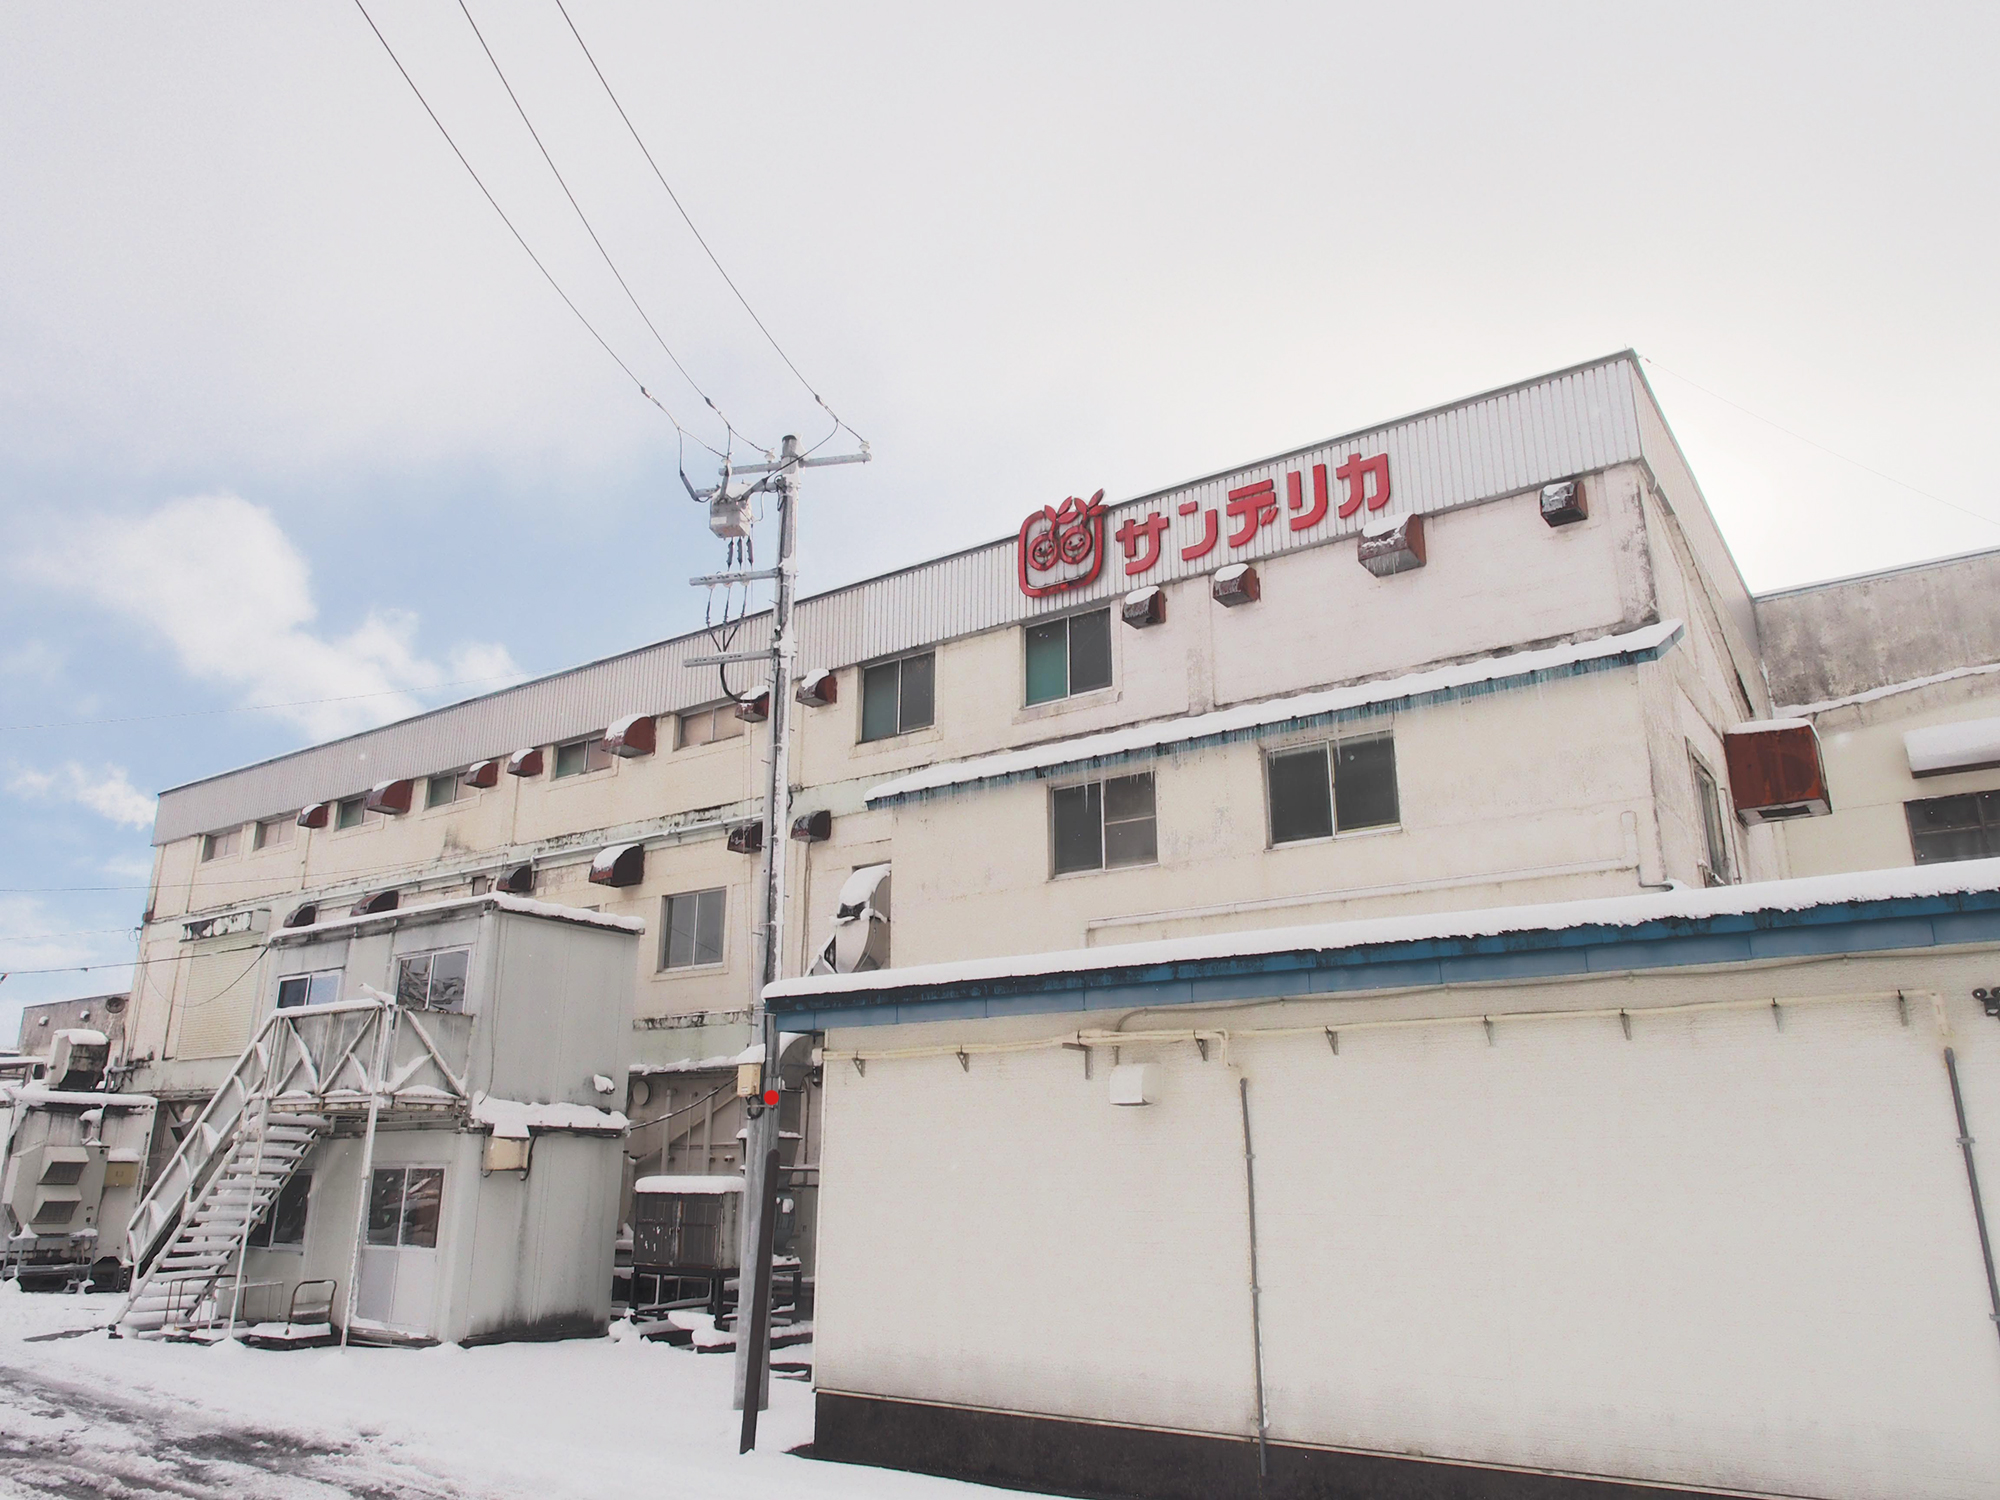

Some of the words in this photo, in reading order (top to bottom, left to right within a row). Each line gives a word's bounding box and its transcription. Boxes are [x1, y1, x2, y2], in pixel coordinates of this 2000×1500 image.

[1116, 453, 1391, 576] サンデリカ
